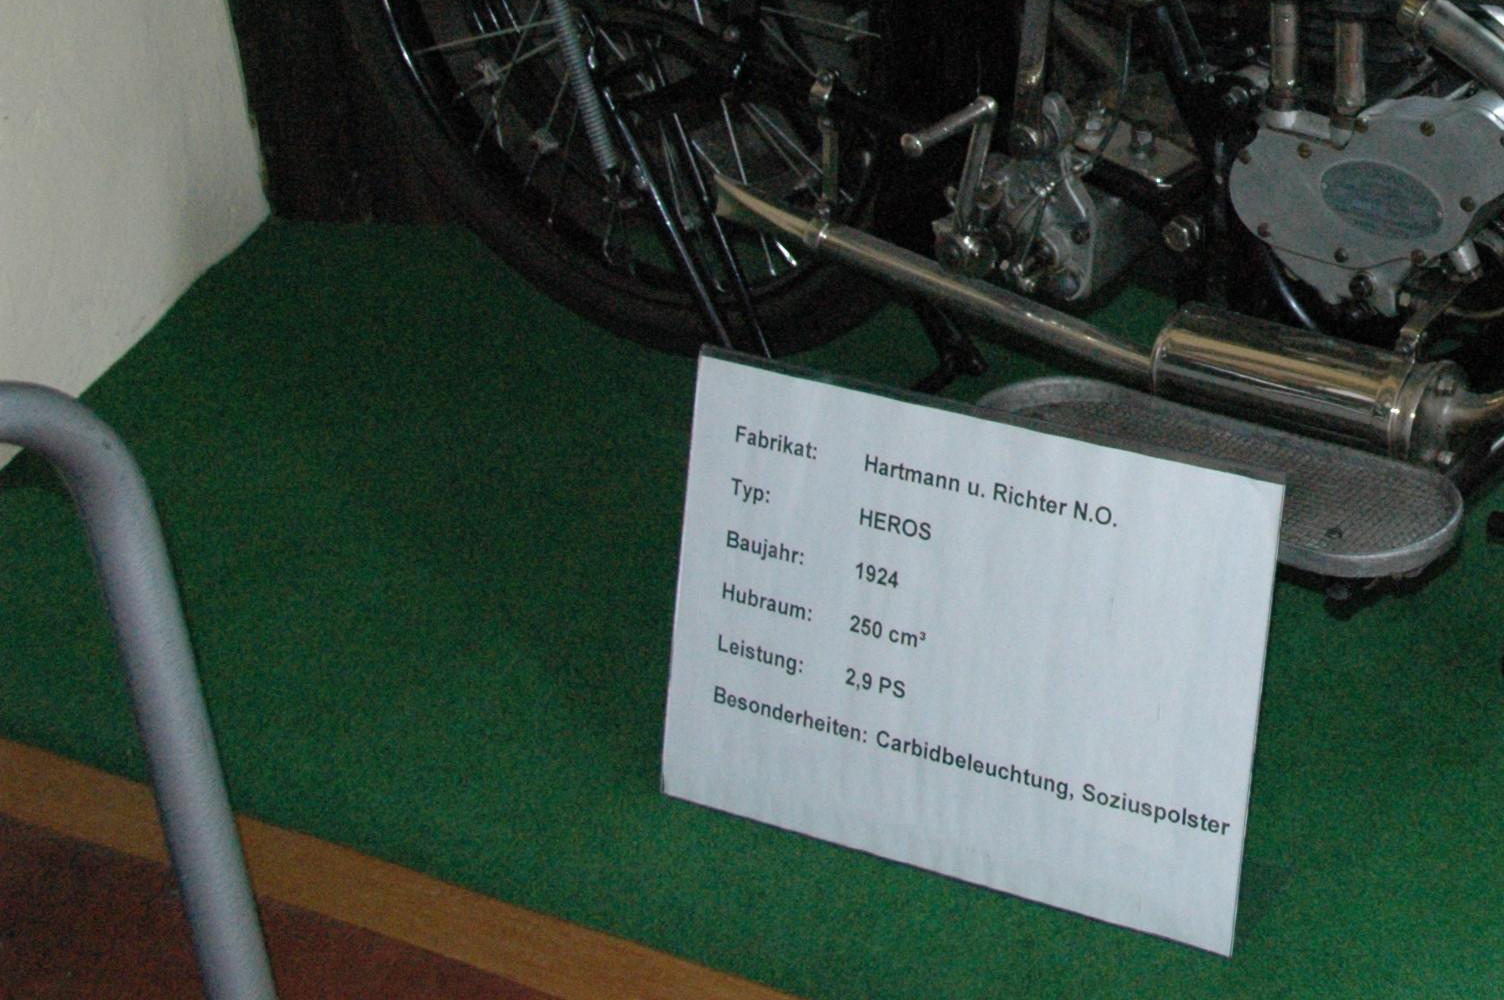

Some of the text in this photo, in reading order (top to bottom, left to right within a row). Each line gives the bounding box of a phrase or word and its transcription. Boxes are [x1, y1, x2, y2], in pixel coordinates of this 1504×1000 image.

[731, 477, 932, 541] Typ: HEROS
[736, 425, 1118, 528] Fabrikat: Hartmann u. Richter N.O.
[726, 529, 899, 589] Baujahr: 1924
[722, 582, 813, 622] Hubraum:
[849, 614, 883, 640] 250
[717, 633, 906, 699] Leistung: 2,9 PS
[713, 685, 1231, 836] Besonderheiten: Carbidbeleuchtung, Soziuspolster
